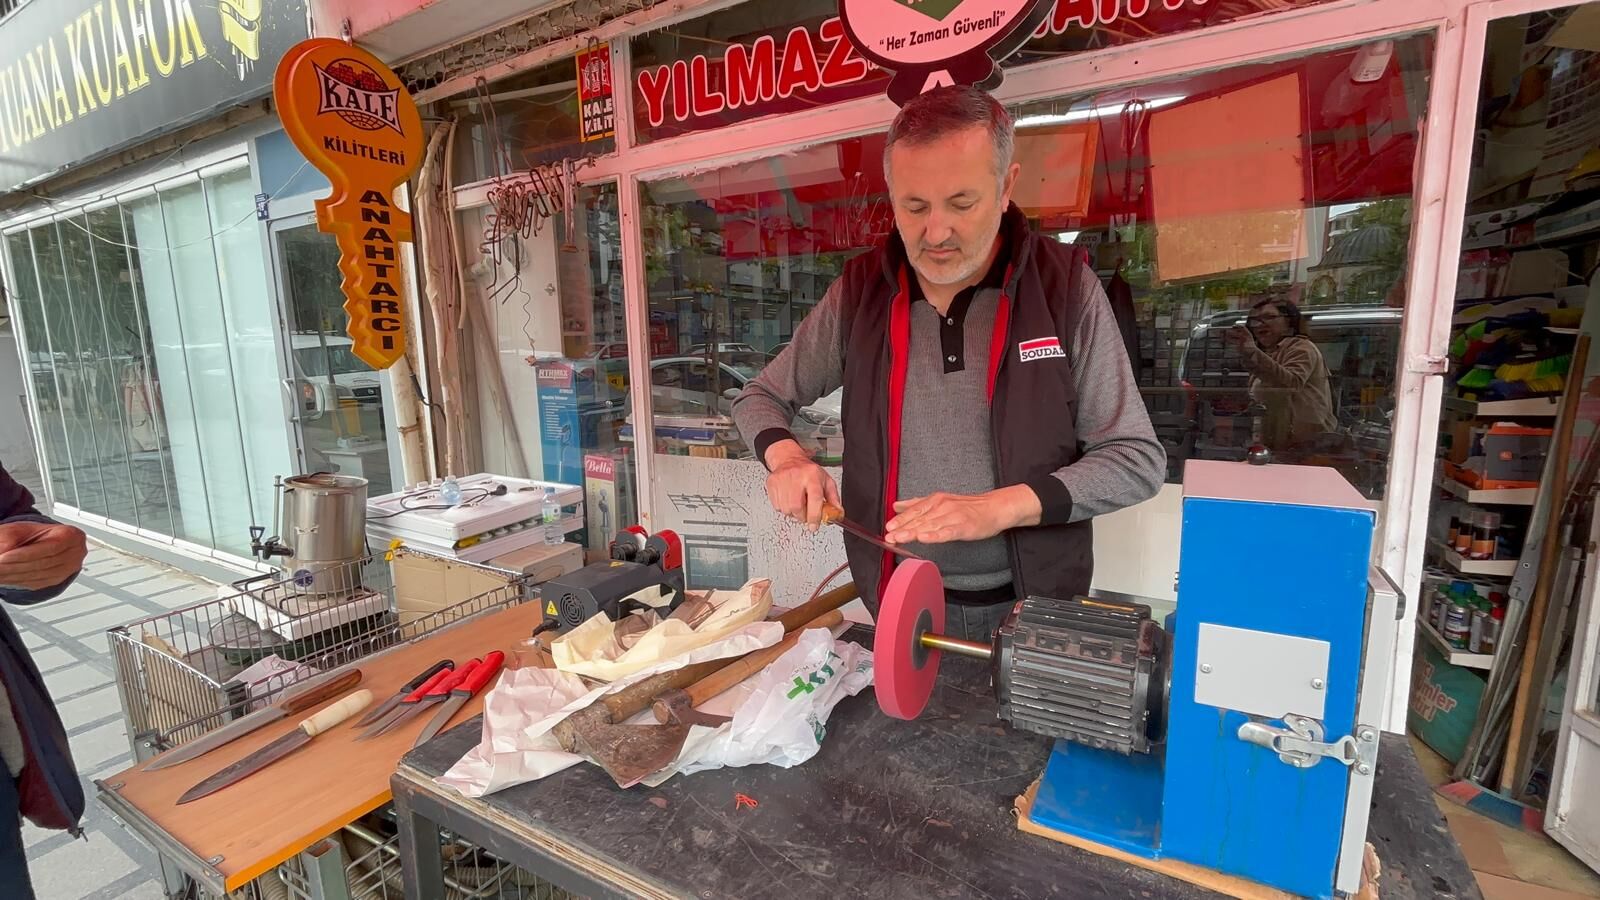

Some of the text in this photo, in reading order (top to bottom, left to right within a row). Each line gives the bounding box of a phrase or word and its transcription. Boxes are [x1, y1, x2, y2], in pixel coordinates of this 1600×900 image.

[909, 27, 950, 46] Zaman
[638, 16, 867, 127] YILMAZ
[323, 73, 396, 126] KALE
[323, 135, 405, 166] KİLİTLERİ
[359, 190, 401, 350] ANAHTARCI
